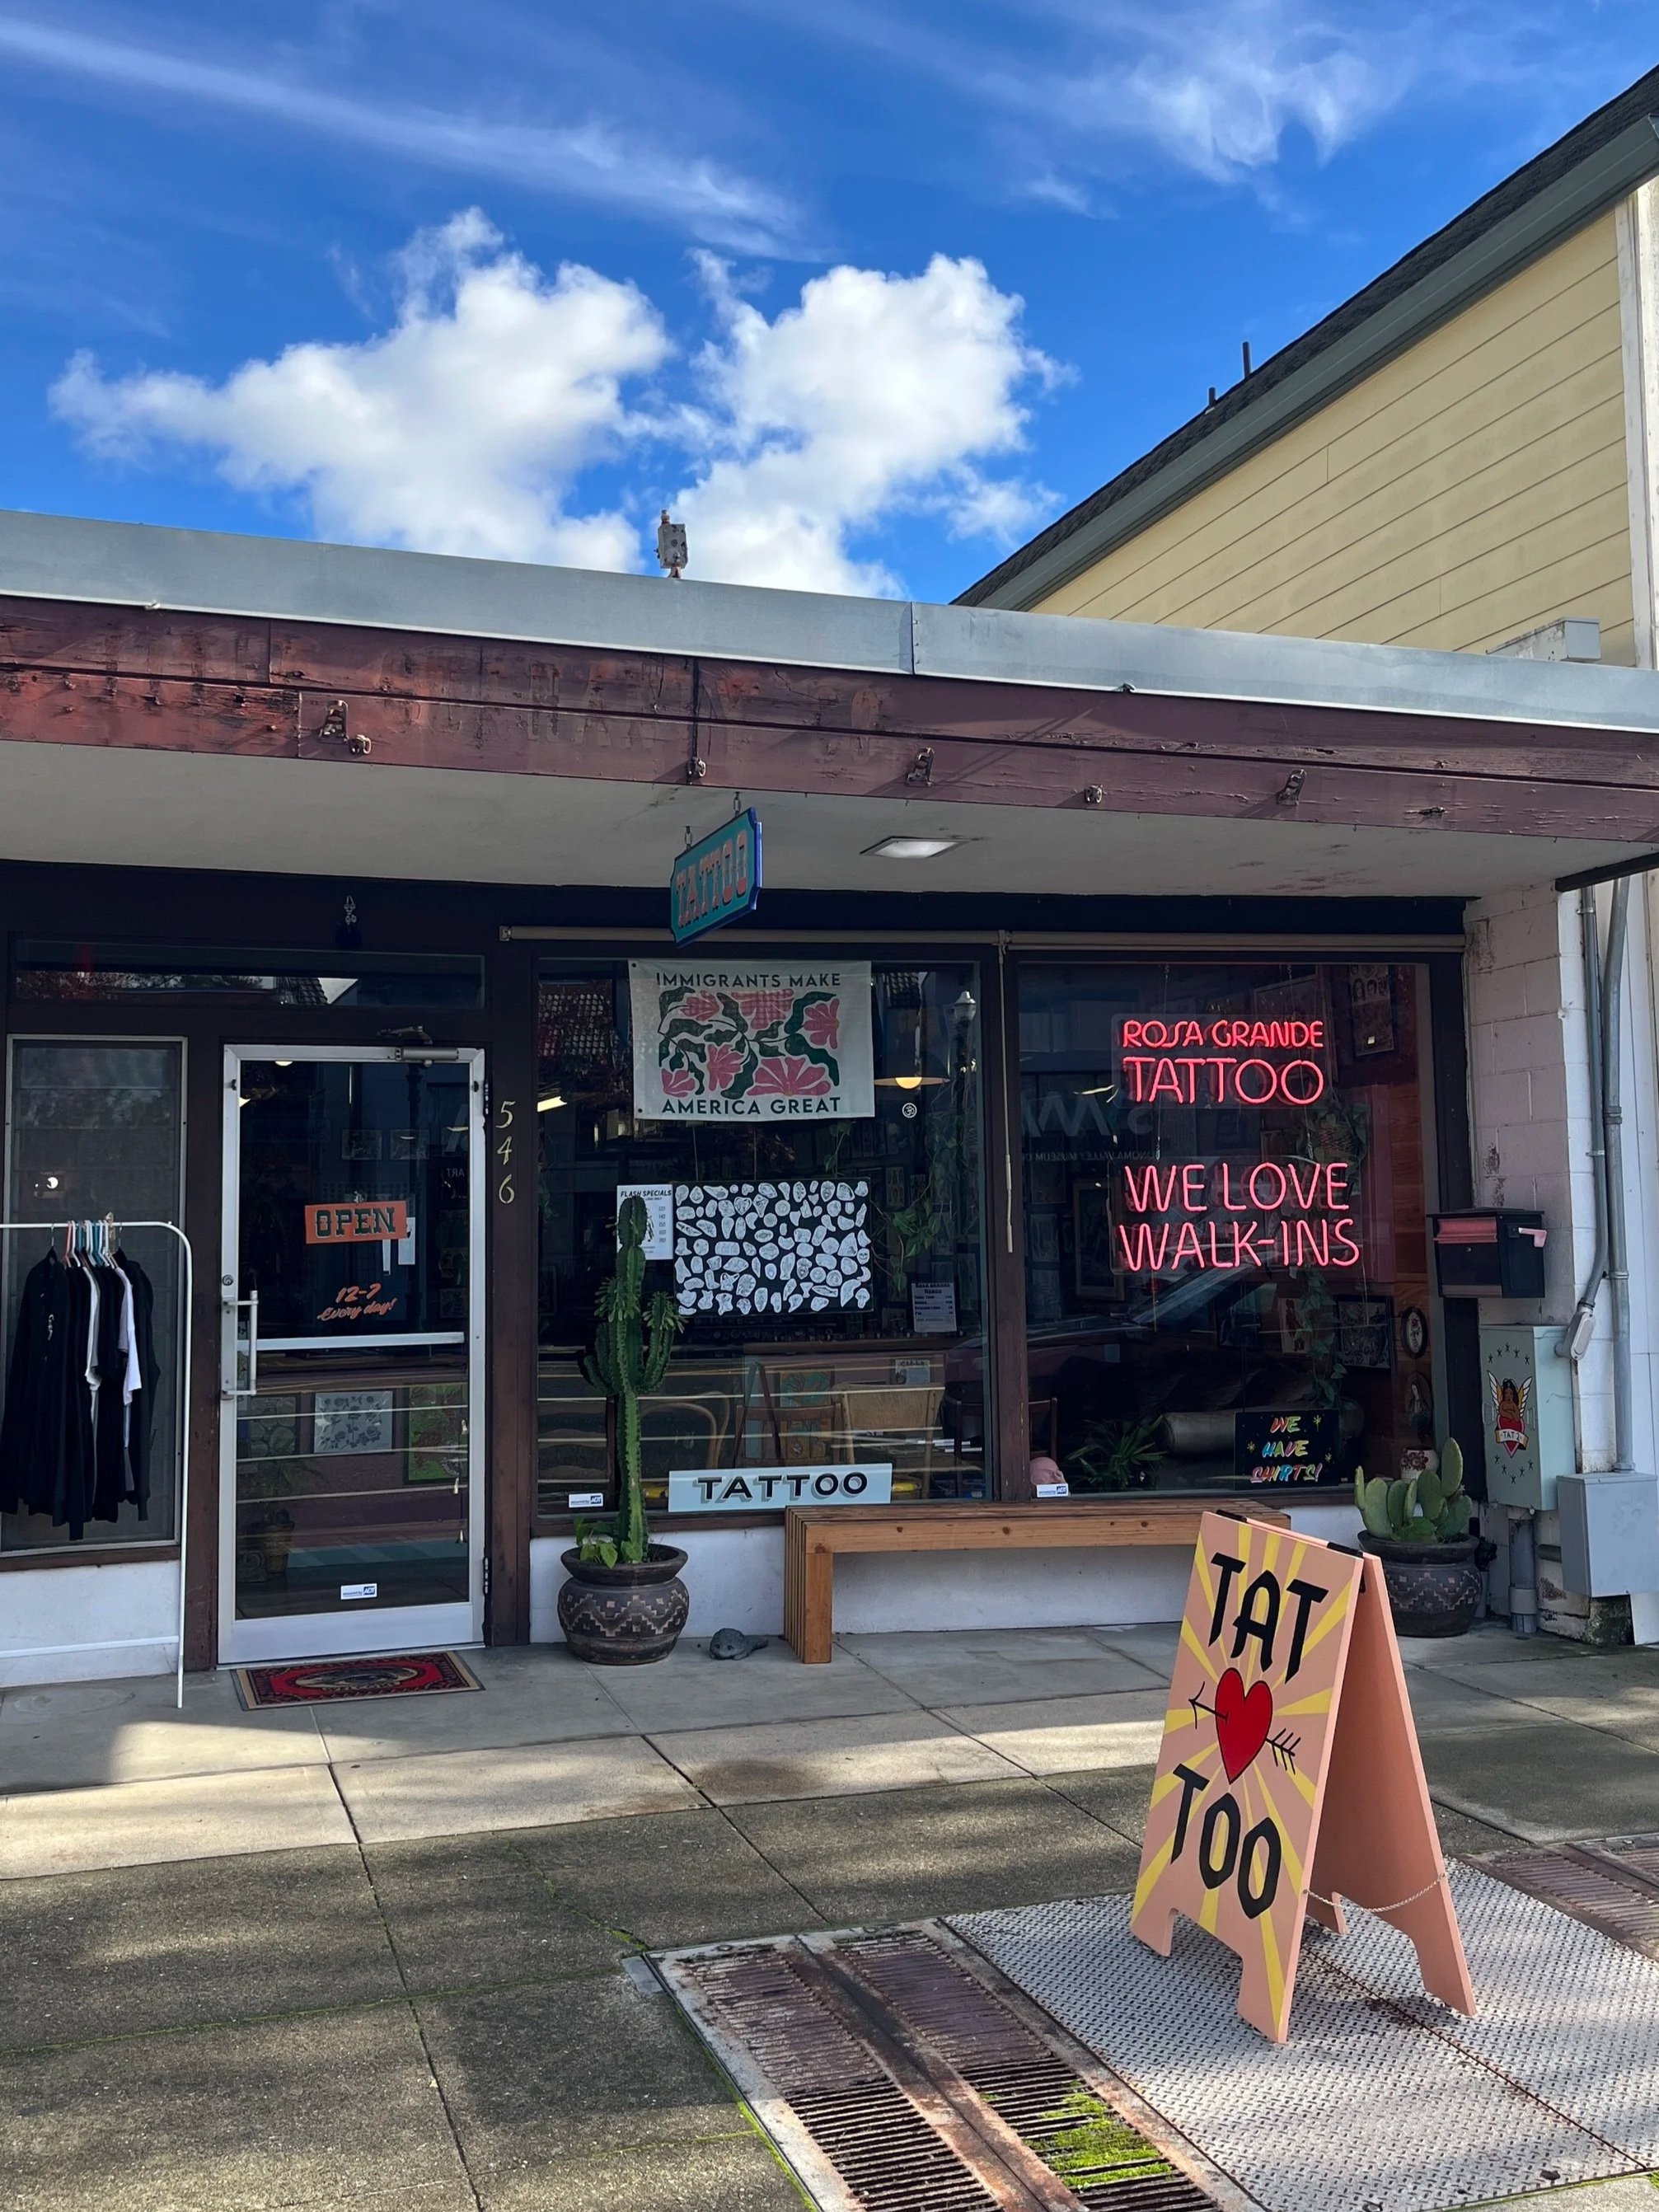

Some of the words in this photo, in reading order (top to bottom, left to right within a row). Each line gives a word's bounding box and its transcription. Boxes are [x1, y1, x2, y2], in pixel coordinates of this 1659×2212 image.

[676, 830, 747, 930] TATTOO
[656, 972, 781, 987] IMMIGRANTS
[789, 972, 841, 987] MAKE
[1122, 1020, 1203, 1047] ROSA
[1211, 1019, 1324, 1047] GRANDE
[1122, 1057, 1324, 1104] TATTOO
[662, 1099, 759, 1115] AMERICA
[770, 1097, 841, 1113] GREAT
[495, 1100, 516, 1204] 546
[1124, 1164, 1207, 1211] WE
[1222, 1162, 1349, 1211] LOVE
[316, 1207, 396, 1239] OPEN
[1119, 1218, 1360, 1271] WALK-INS
[335, 1282, 382, 1304] 12-7
[316, 1306, 363, 1321] Every
[363, 1297, 398, 1315] day!
[1270, 1416, 1301, 1433] WE
[1502, 1431, 1515, 1440] TAT
[1262, 1440, 1309, 1458] HAVE
[695, 1471, 868, 1502] TATTOO
[1250, 1463, 1323, 1483] SHIRTS!
[1208, 1552, 1329, 1684] TAT
[1170, 1763, 1282, 1919] TOO
